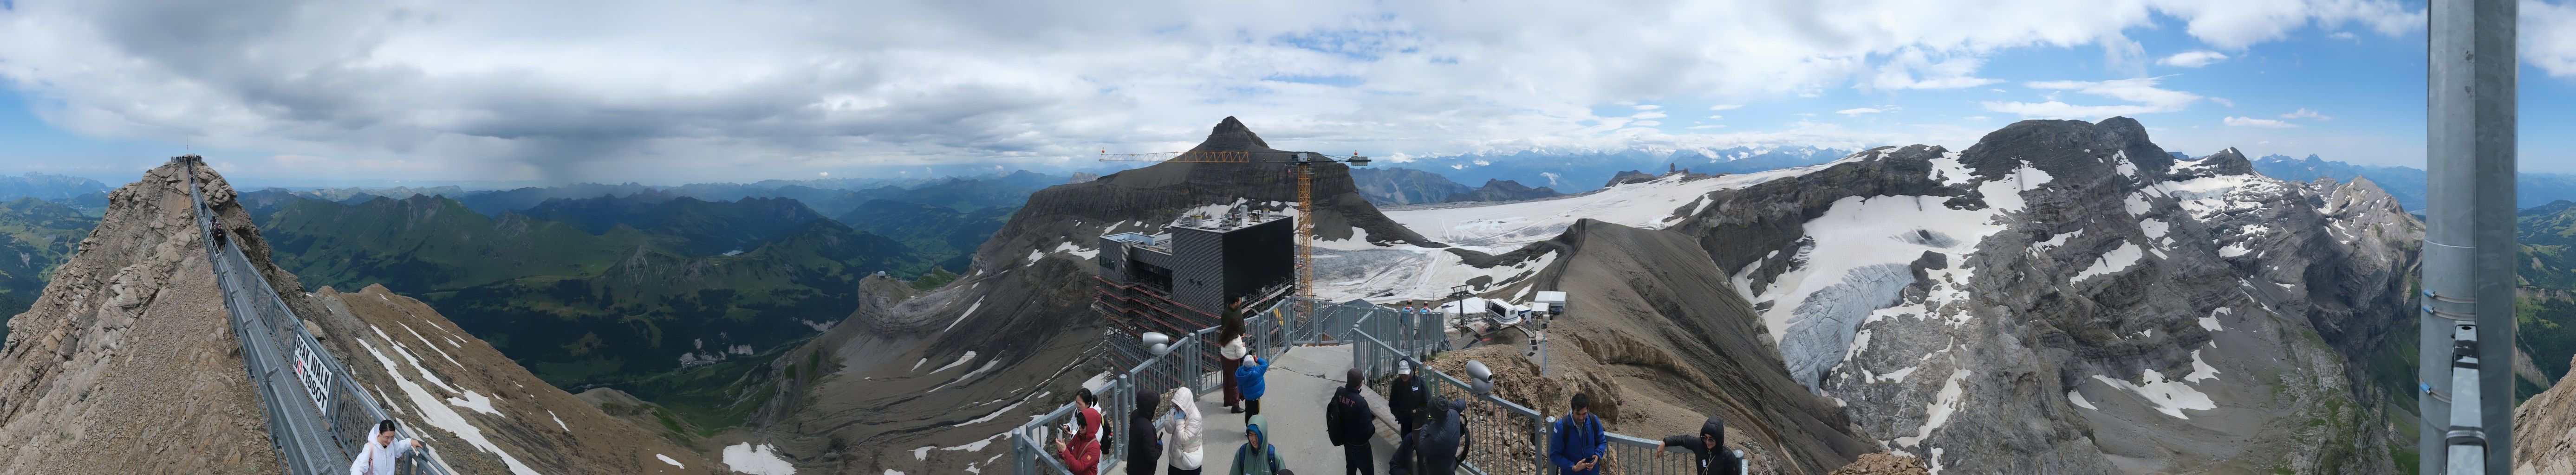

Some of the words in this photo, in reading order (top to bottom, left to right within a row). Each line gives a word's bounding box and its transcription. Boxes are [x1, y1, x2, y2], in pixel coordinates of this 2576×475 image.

[296, 336, 310, 366] PEAK
[311, 354, 330, 392] WALK
[302, 365, 326, 409] TISSOT
[1339, 395, 1355, 407] GANT
